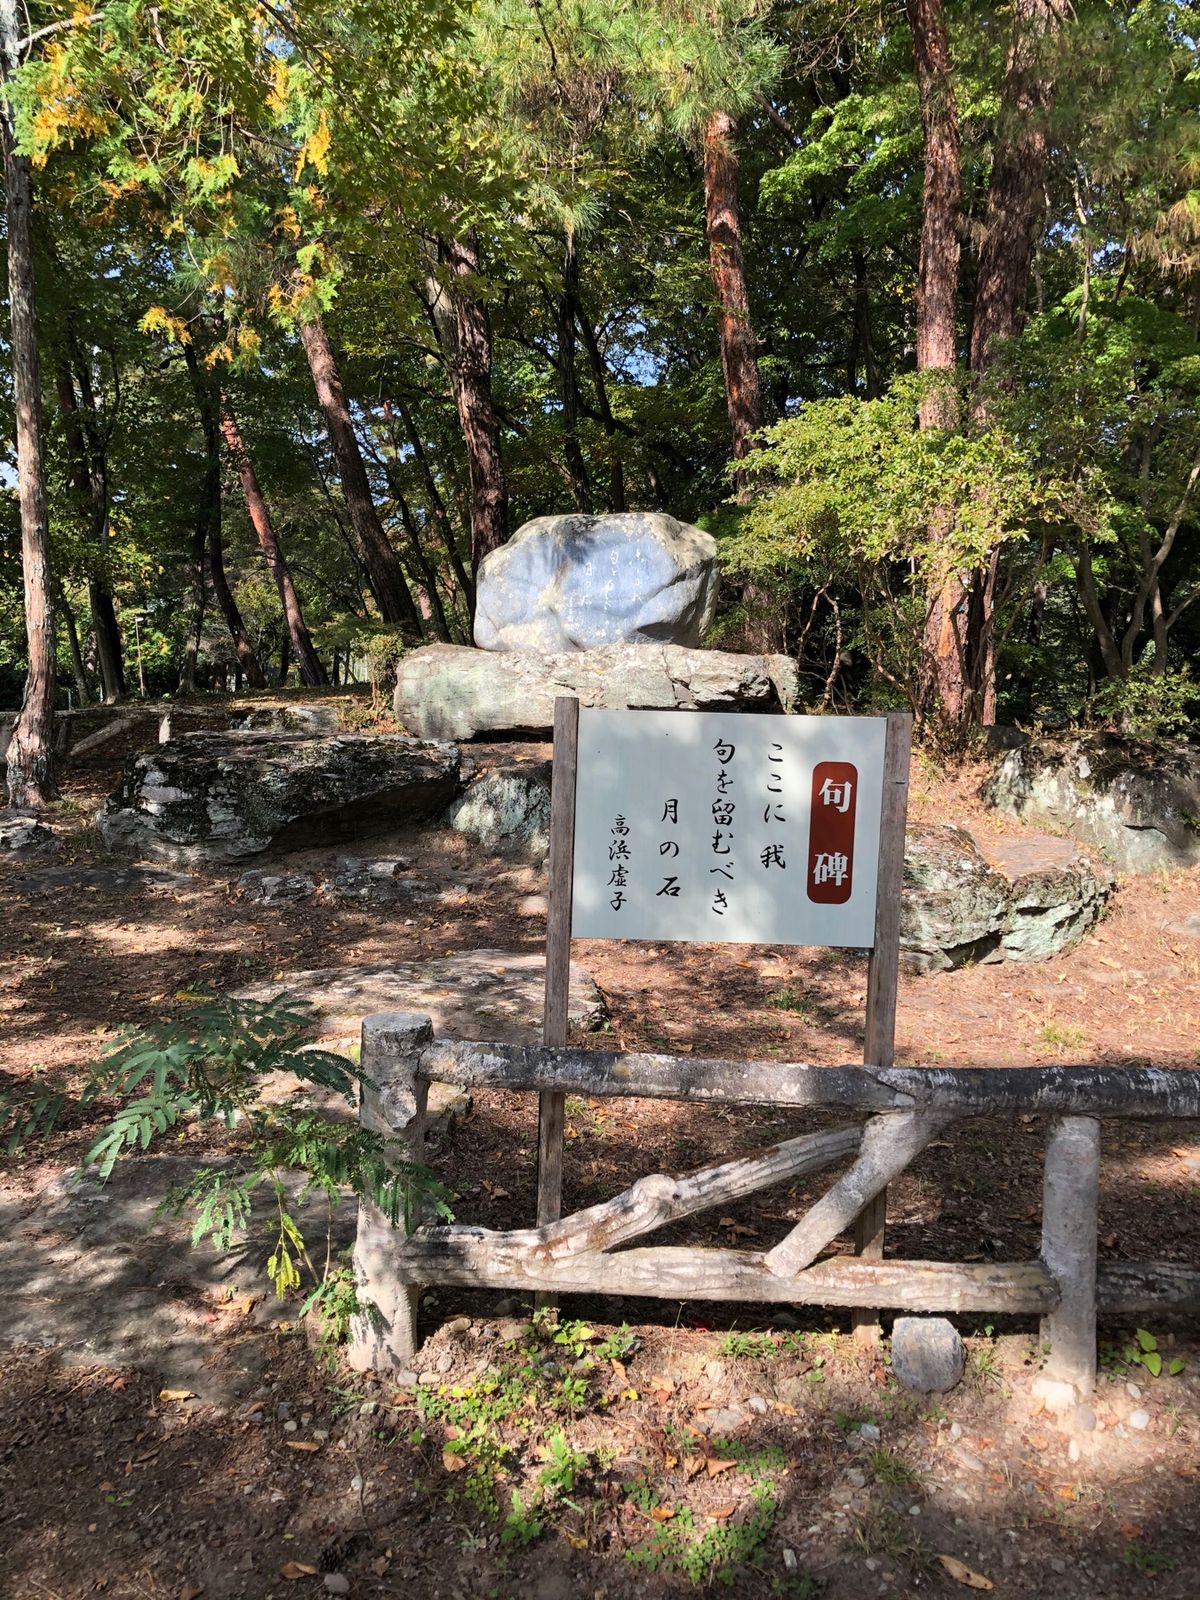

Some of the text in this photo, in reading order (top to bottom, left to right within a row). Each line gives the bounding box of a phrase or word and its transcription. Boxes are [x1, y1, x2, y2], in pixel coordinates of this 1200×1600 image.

[607, 814, 632, 912] 高浜虚子
[656, 798, 681, 898] 月の石
[709, 738, 736, 916] 句を留むべき
[813, 778, 852, 887] 句碑
